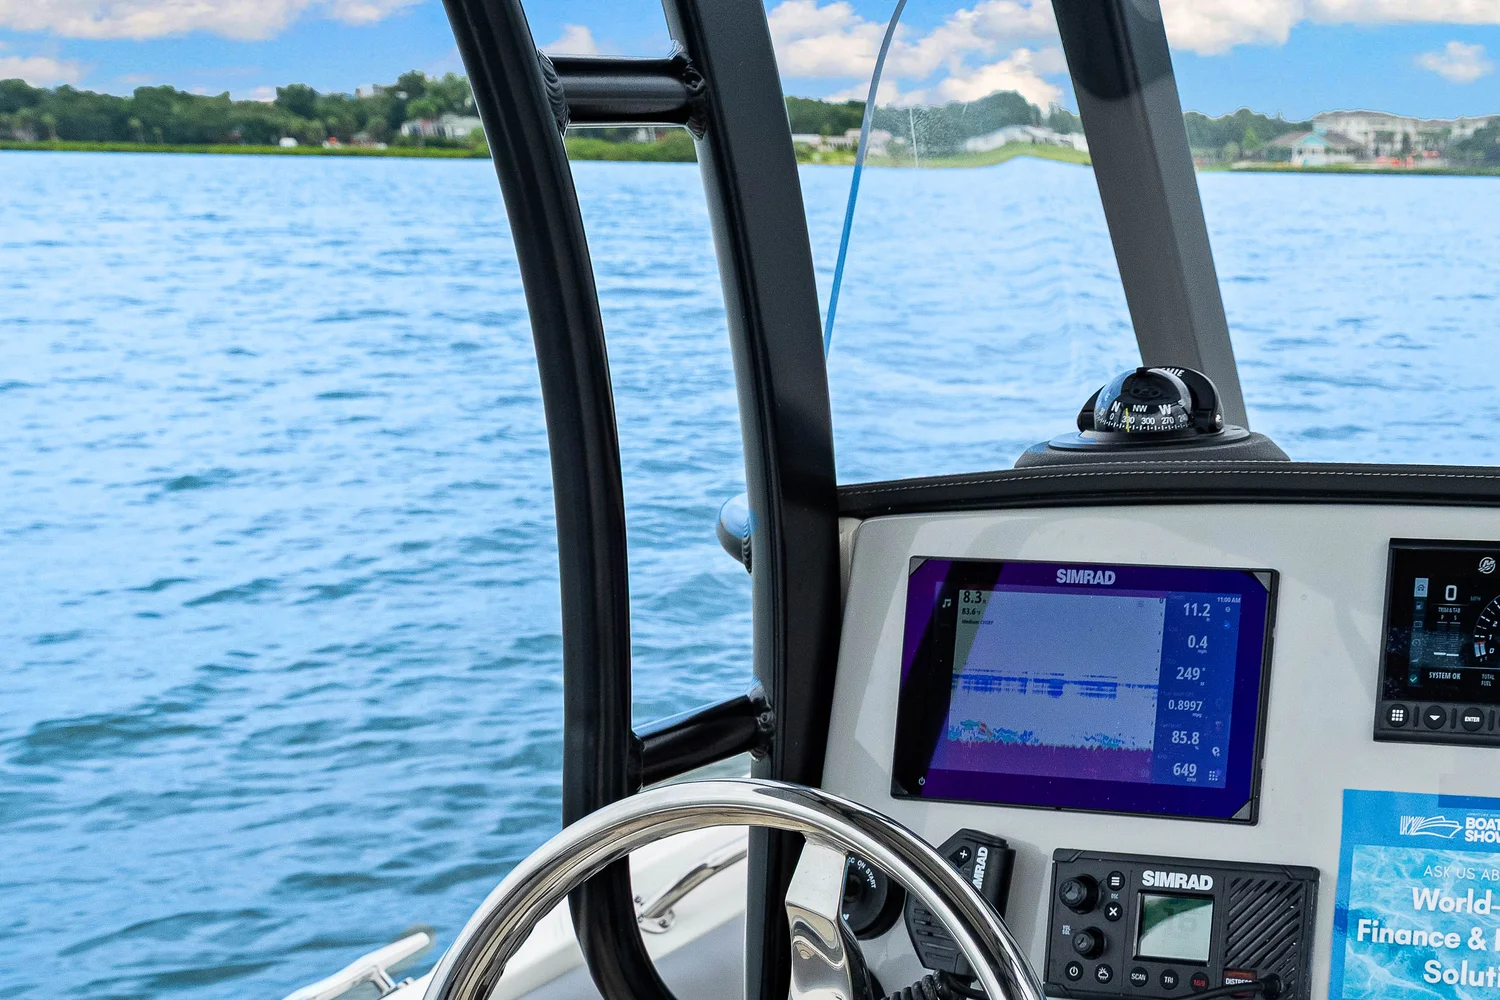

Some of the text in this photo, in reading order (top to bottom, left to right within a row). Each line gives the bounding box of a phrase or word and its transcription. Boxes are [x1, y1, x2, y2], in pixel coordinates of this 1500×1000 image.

[1111, 401, 1121, 412] N
[1159, 405, 1171, 415] W
[1056, 569, 1116, 585] SIMRAD
[962, 591, 982, 603] 8.3
[1445, 585, 1457, 601] 0
[1183, 603, 1210, 617] 11.2
[1188, 635, 1208, 648] 0.4
[1168, 699, 1202, 711] 0.8997
[1172, 731, 1200, 744] 85.8
[1173, 762, 1197, 777] 649
[857, 860, 866, 868] ON
[866, 868, 876, 888] START
[1423, 865, 1451, 878] ASK
[1456, 867, 1475, 880] US
[1142, 870, 1213, 891] SIMRAD
[1357, 919, 1461, 949] Finance
[1467, 927, 1486, 950] &
